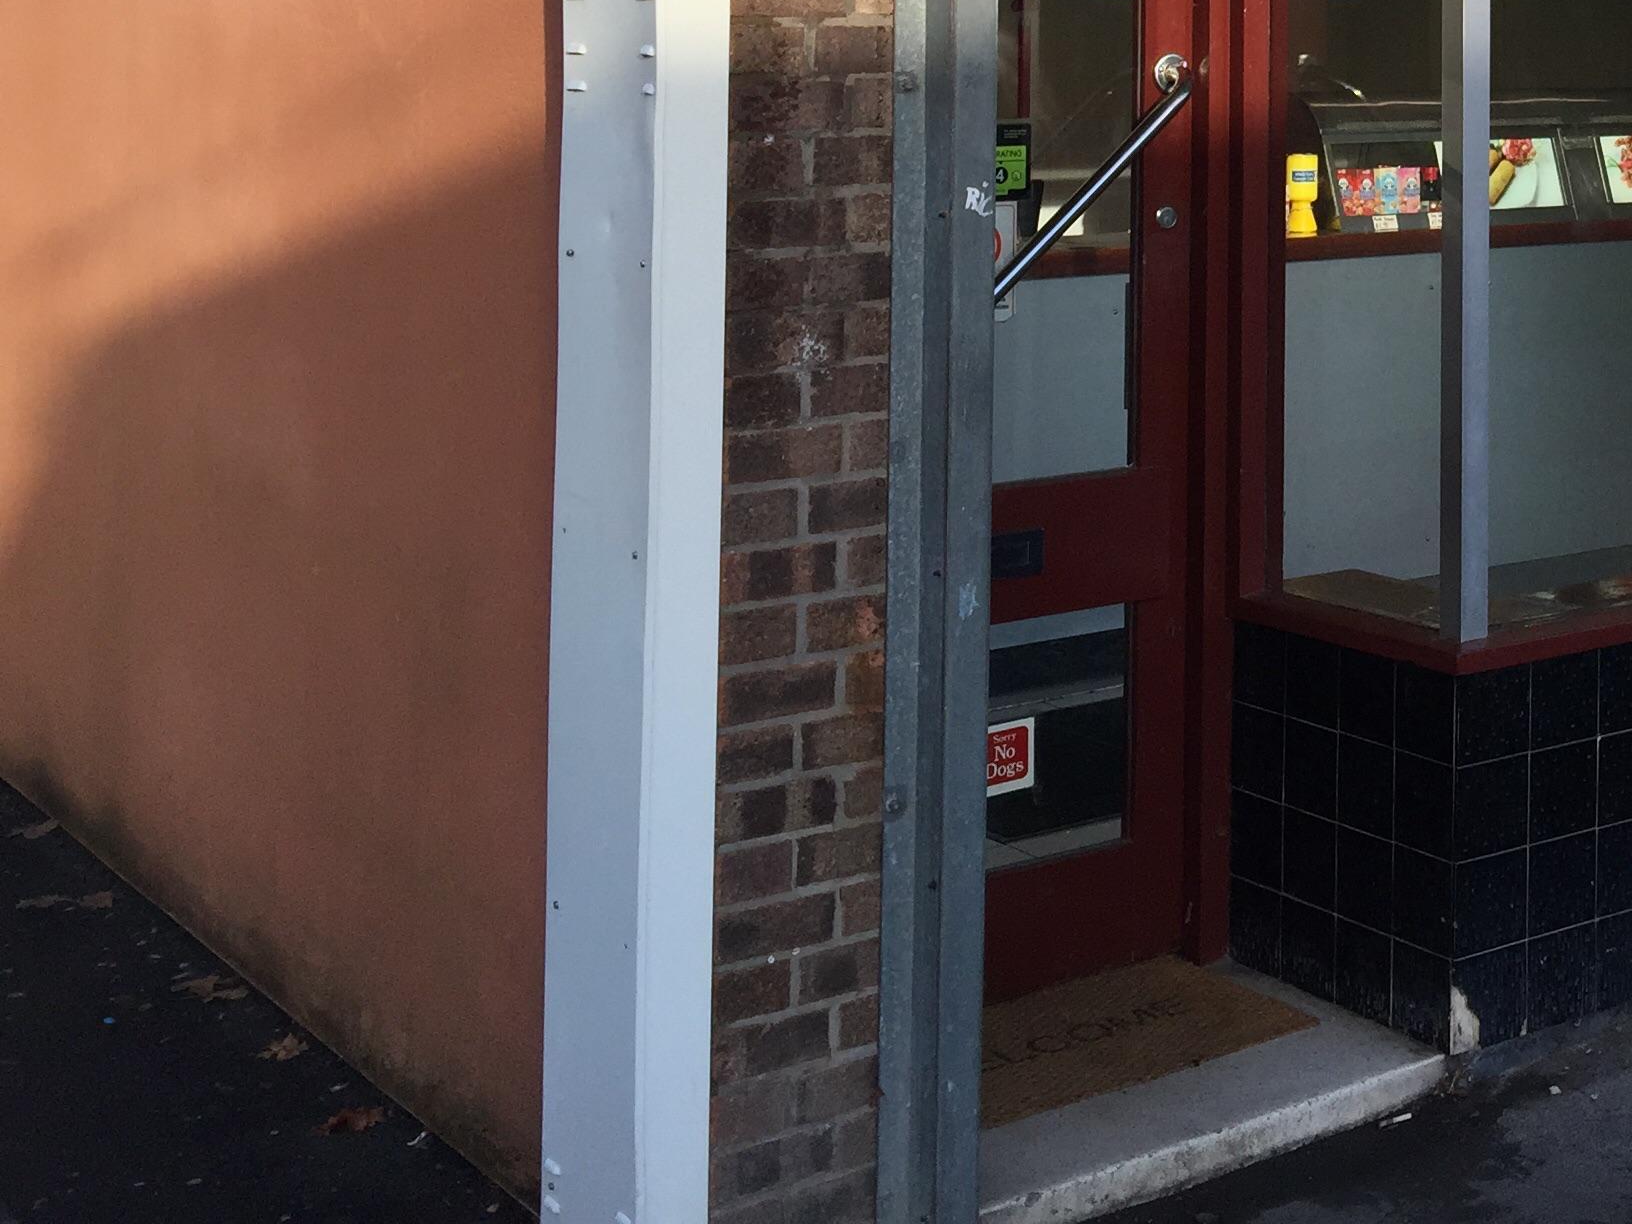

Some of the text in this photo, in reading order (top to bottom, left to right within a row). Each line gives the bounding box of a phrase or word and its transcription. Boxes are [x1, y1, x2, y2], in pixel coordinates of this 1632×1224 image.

[996, 168, 1005, 183] 4
[992, 732, 1017, 744] Sorry
[994, 743, 1016, 762] No
[986, 760, 1024, 780] Dogs
